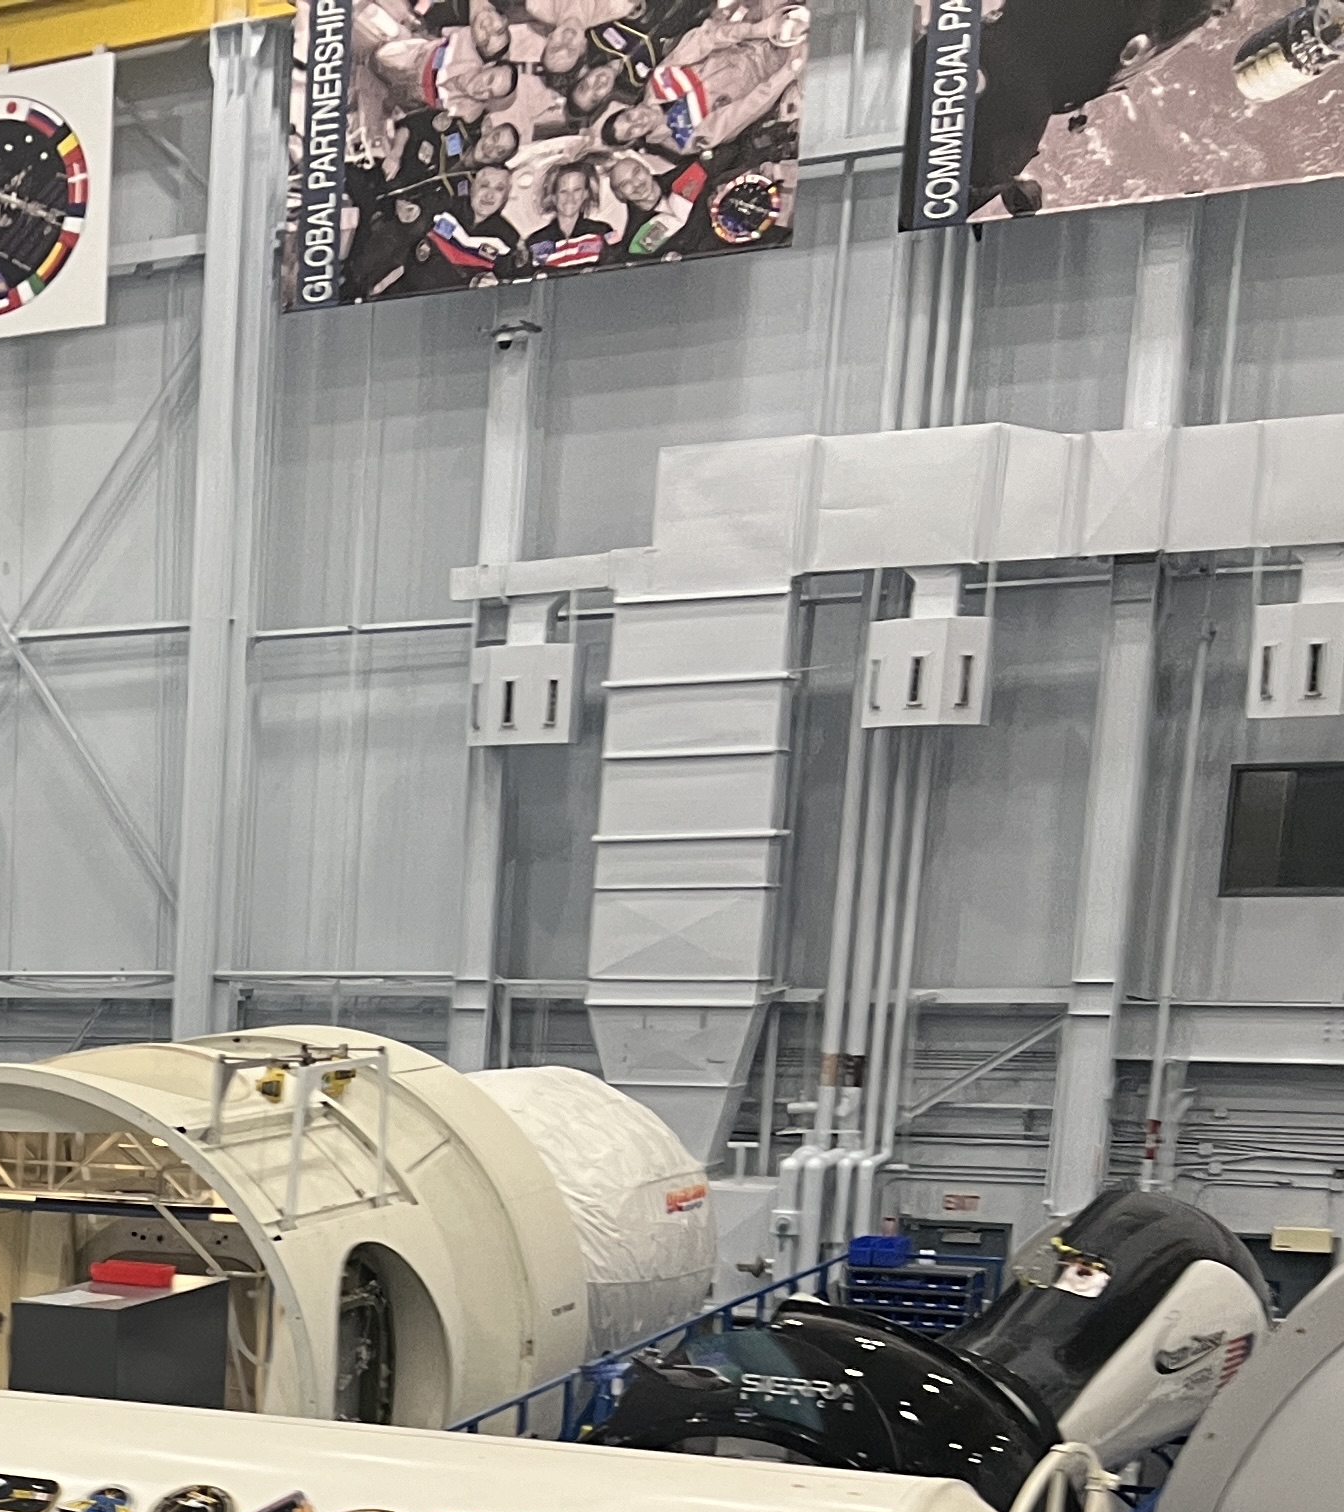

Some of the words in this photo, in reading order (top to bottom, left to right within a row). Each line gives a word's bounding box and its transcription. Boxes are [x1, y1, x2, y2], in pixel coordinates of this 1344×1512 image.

[923, 33, 972, 219] COMMERCIAL
[302, 193, 336, 303] GLOBAL
[740, 1373, 855, 1400] SIERRA
